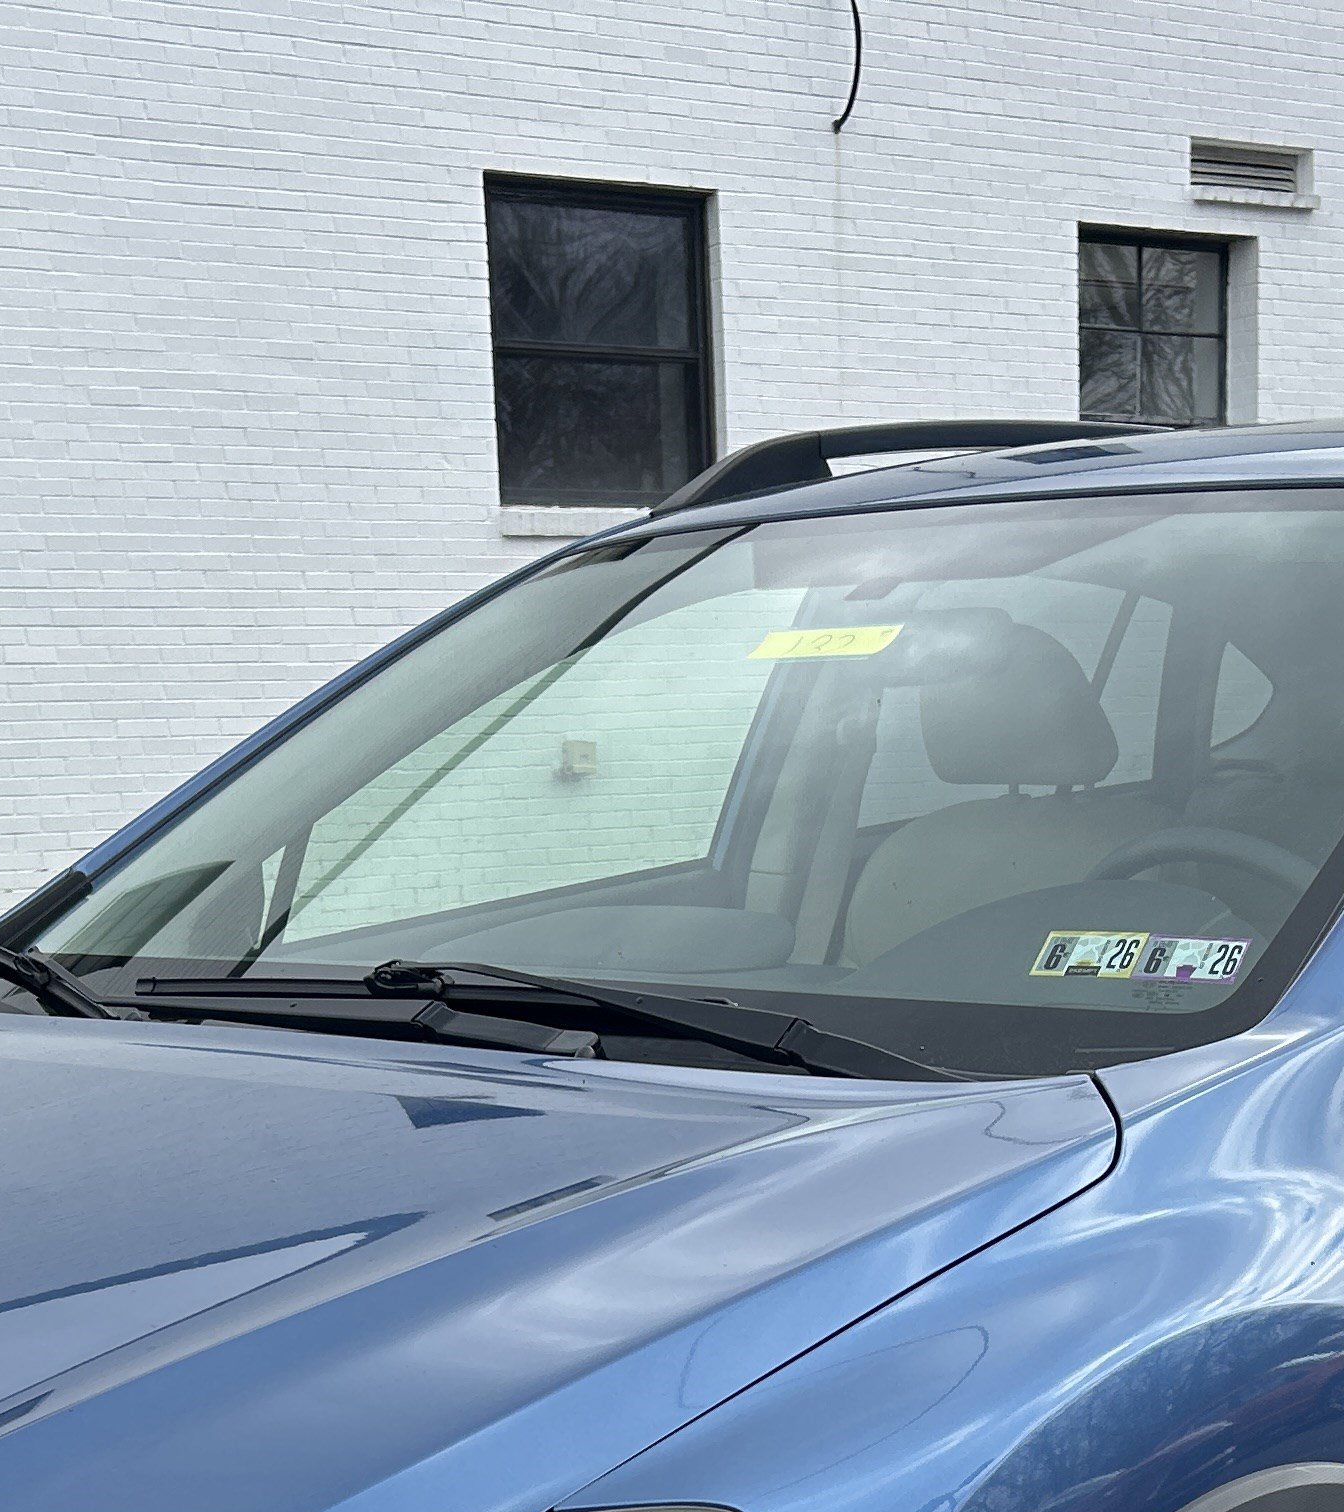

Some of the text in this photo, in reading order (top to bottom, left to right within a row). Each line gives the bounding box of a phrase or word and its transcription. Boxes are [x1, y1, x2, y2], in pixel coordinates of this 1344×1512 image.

[1044, 939, 1140, 970] 6 26
[1143, 944, 1244, 975] 6 26
